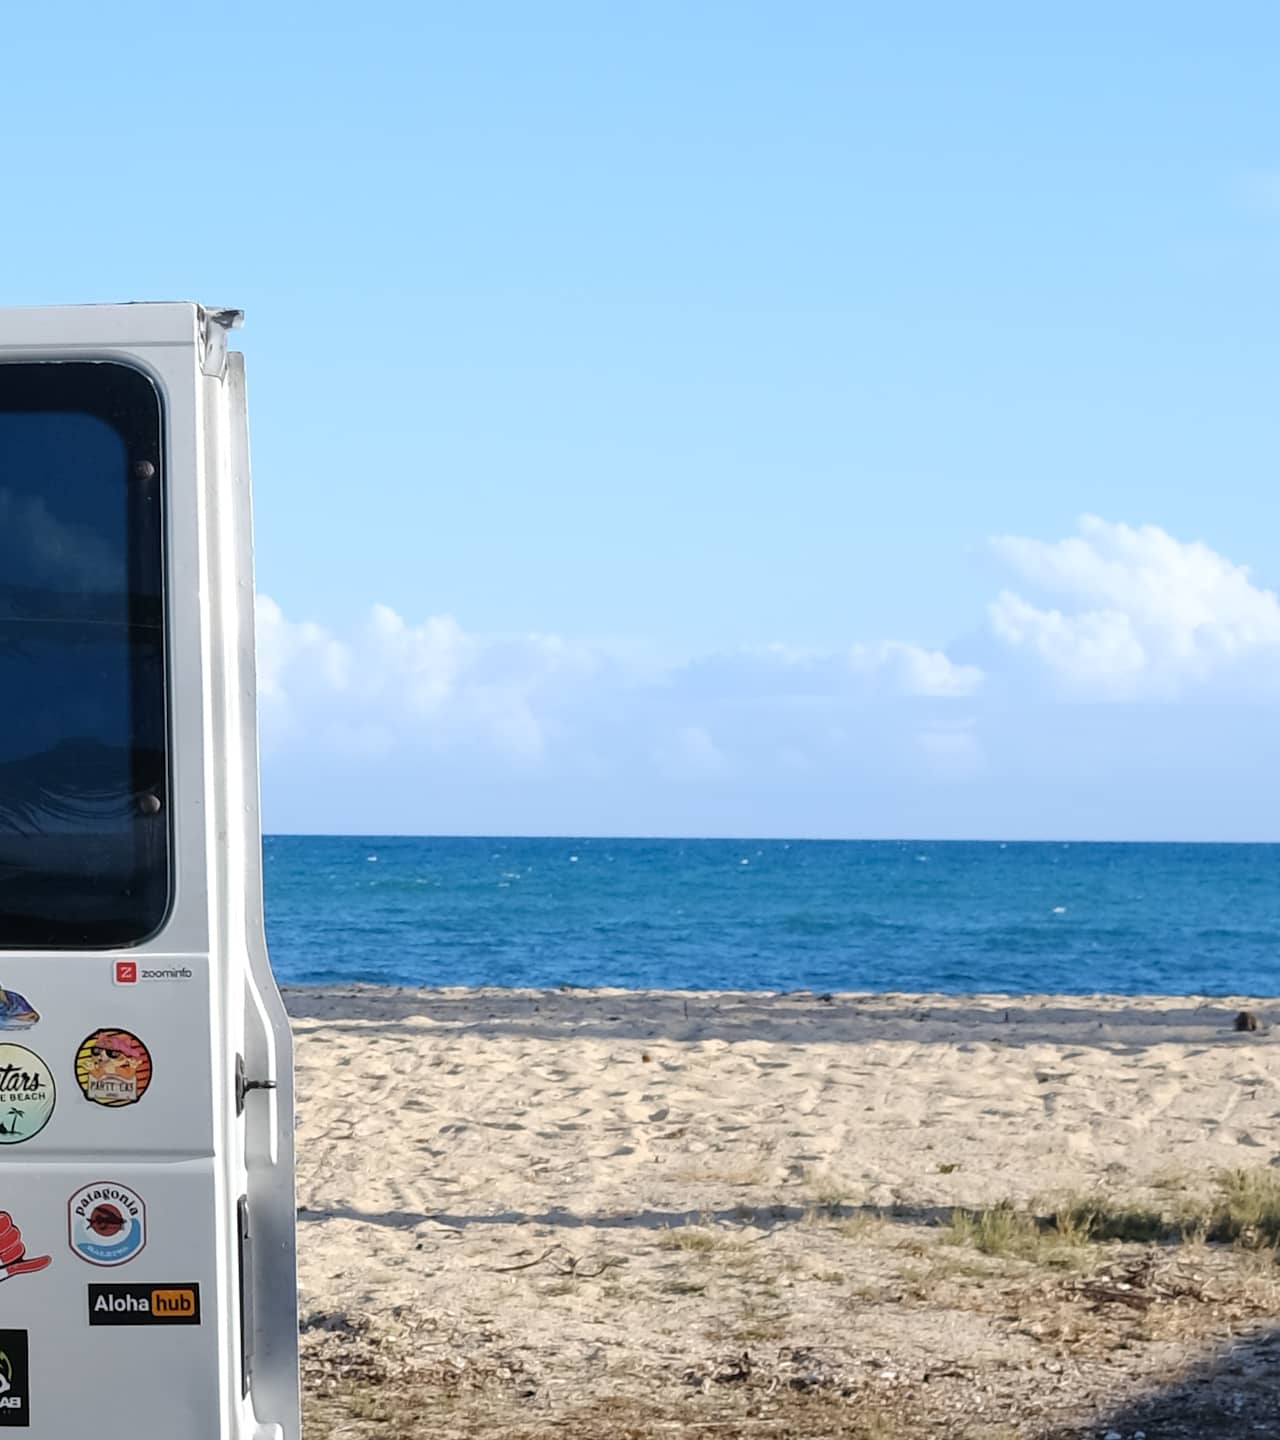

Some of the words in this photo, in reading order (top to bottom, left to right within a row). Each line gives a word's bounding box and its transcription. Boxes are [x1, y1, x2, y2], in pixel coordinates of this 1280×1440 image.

[141, 967, 192, 978] zoominfo
[9, 1092, 46, 1101] BEACH
[75, 1188, 139, 1217] patagonia
[93, 1293, 150, 1312] Aloha
[156, 1294, 192, 1312] hub
